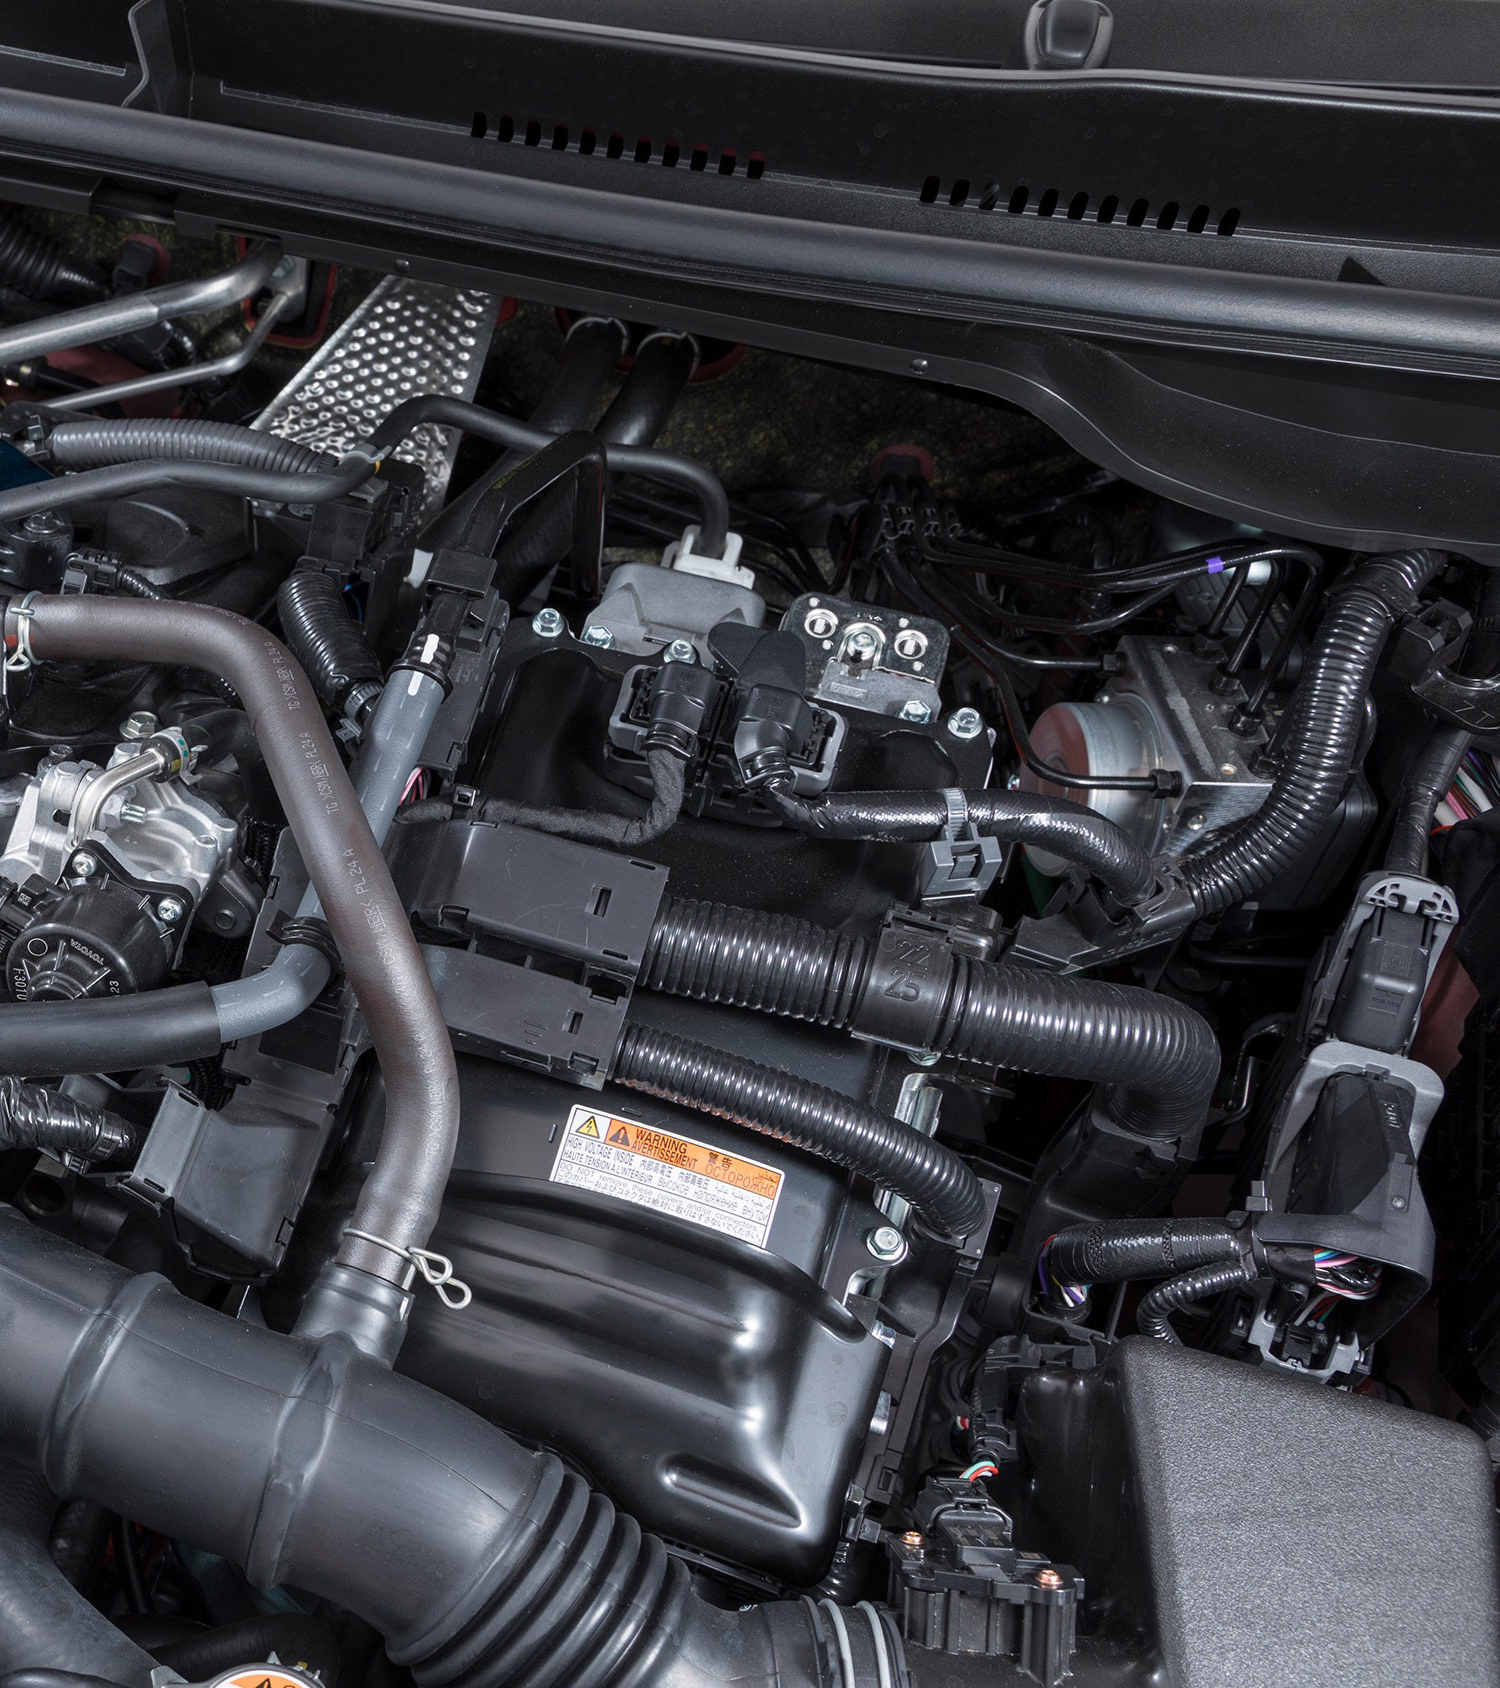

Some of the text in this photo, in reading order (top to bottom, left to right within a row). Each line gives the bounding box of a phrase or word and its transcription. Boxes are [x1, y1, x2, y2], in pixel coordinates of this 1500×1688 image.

[70, 938, 105, 966] TOYOTA
[893, 938, 932, 970] 22
[884, 967, 920, 1002] 25
[567, 1136, 635, 1166] HIGH VOLTAGE INSIDE
[631, 1140, 698, 1169] AVERTISSEMENT
[634, 1129, 688, 1154] WARNING
[563, 1149, 584, 1163] HAUTE
[584, 1155, 611, 1171] TENSION
[560, 1162, 574, 1172] DO
[577, 1167, 596, 1178] NOT
[599, 1175, 629, 1189] remove
[632, 1184, 654, 1197] these
[657, 1193, 683, 1206] covers
[704, 1163, 776, 1197] ОСТОРОЖНО
